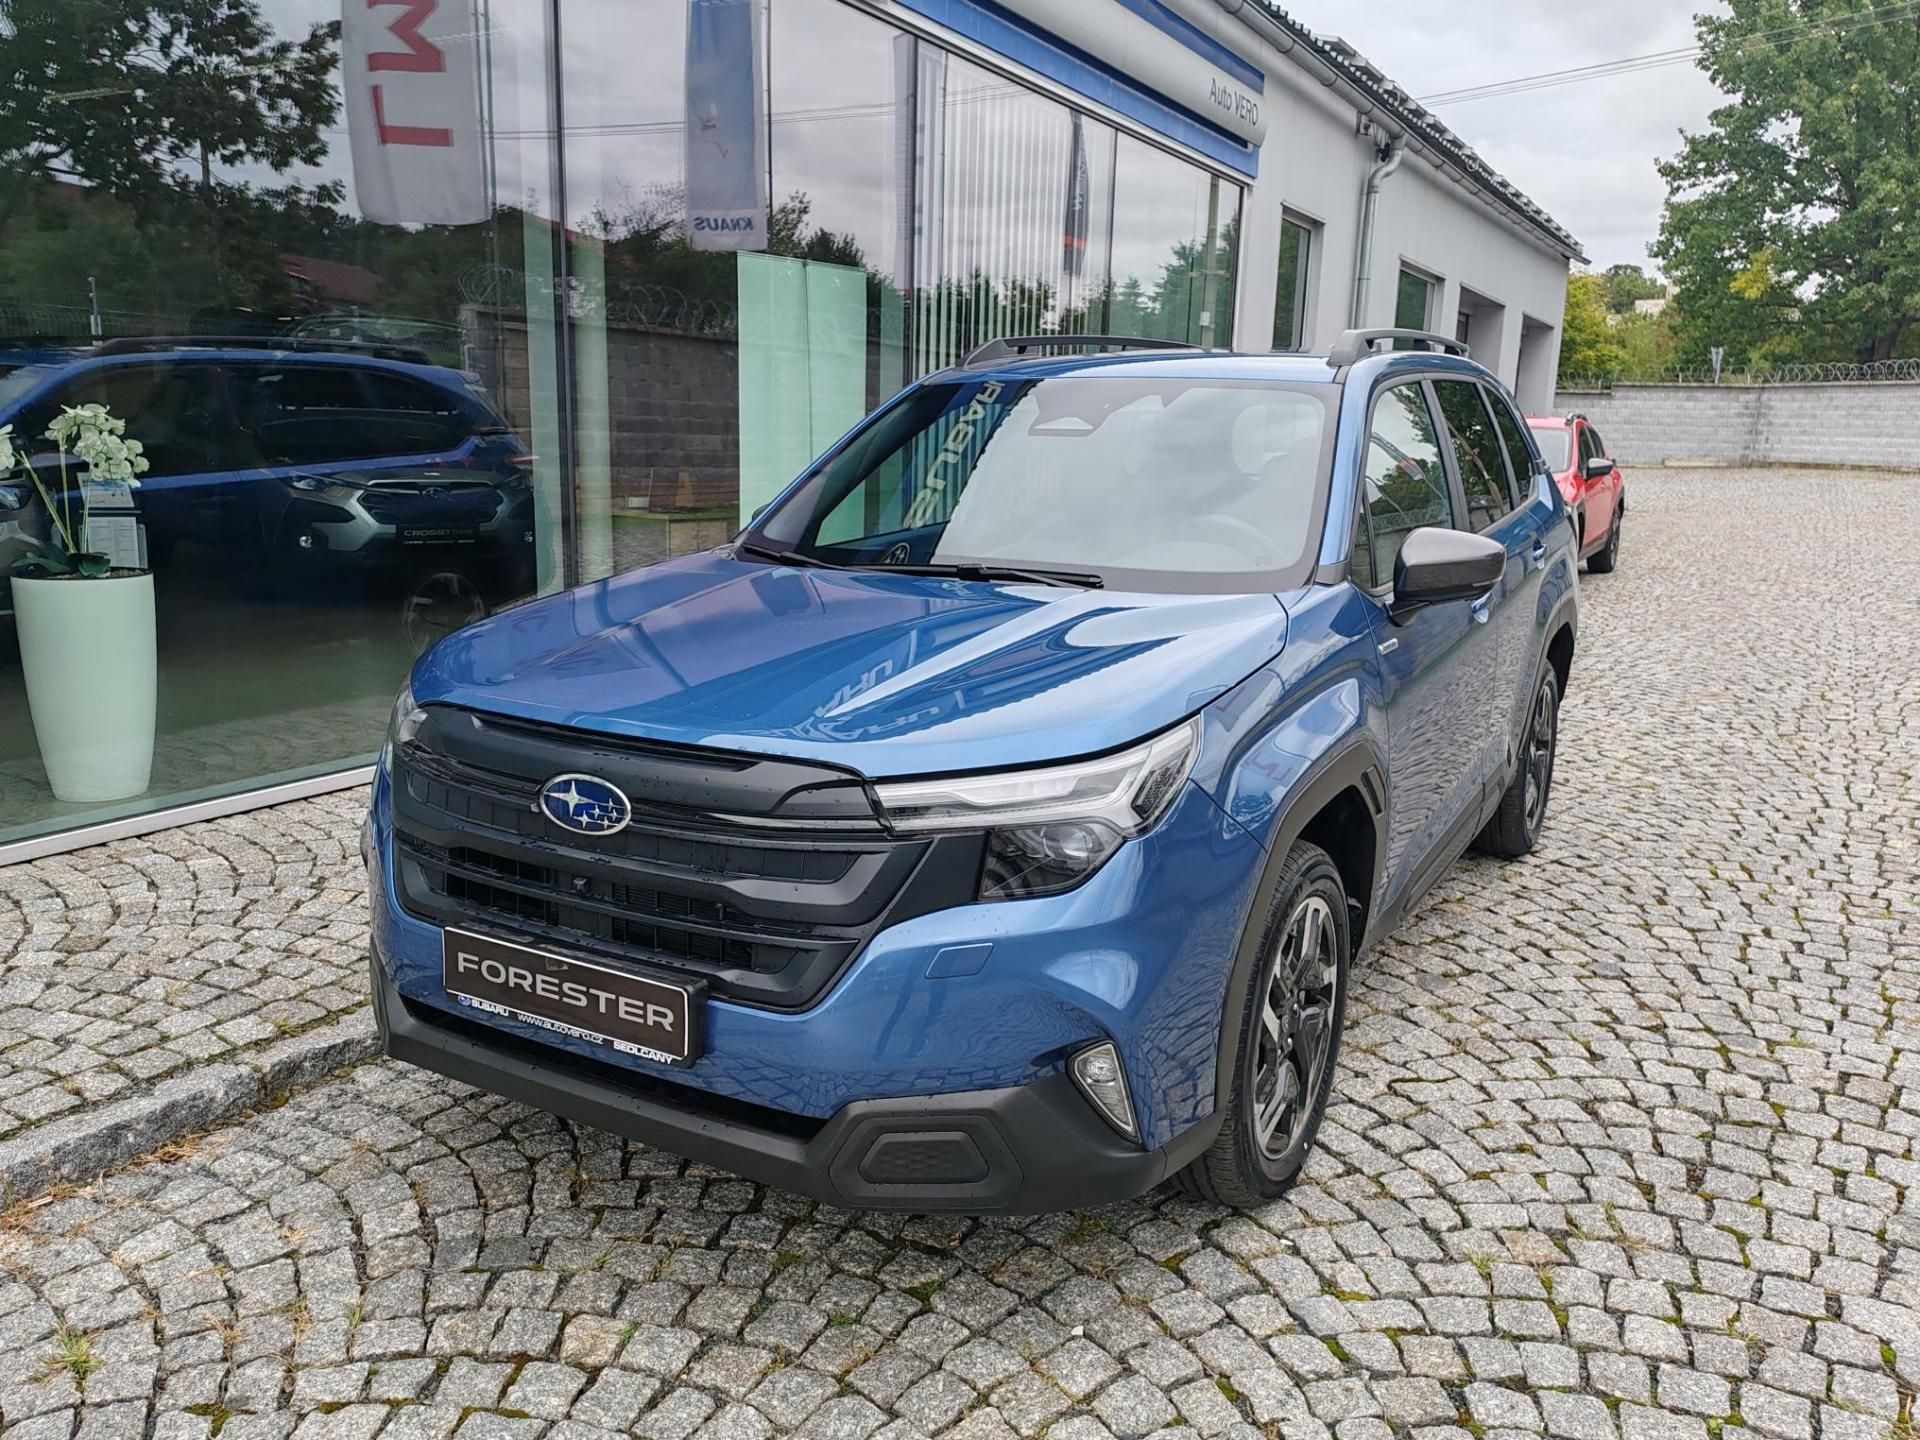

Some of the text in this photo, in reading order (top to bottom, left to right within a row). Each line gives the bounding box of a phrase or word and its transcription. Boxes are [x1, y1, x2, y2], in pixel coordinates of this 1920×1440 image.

[1208, 77, 1259, 126] Auto VERO
[457, 951, 675, 1032] FORESTER
[471, 998, 509, 1017] SUBARU
